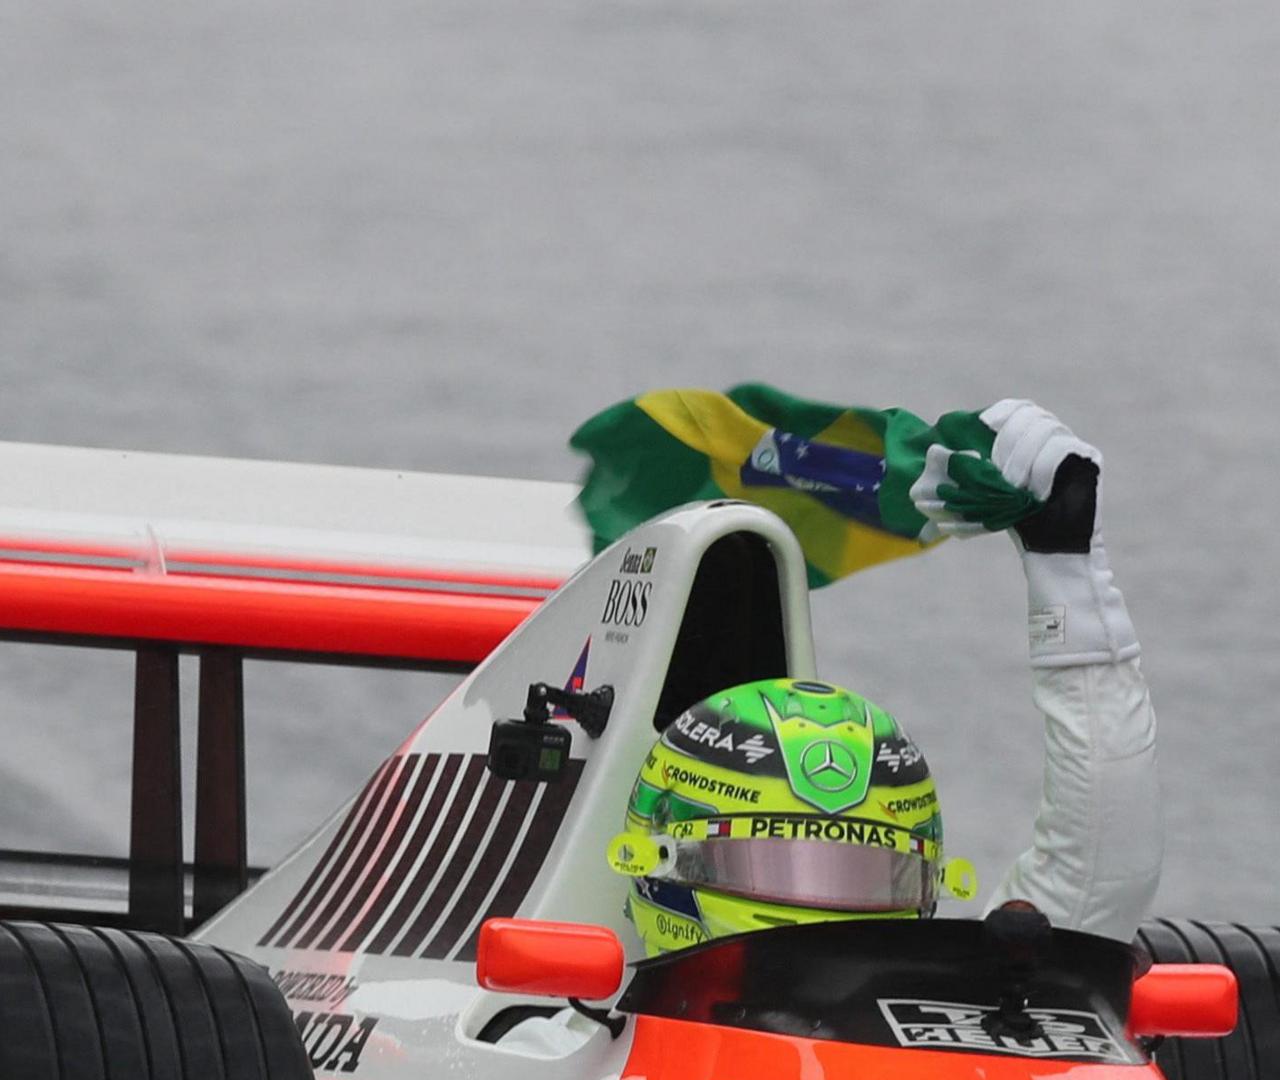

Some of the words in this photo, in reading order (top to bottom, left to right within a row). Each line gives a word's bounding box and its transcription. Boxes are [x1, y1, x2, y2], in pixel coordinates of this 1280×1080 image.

[601, 579, 653, 628] BOSS
[666, 765, 761, 803] CROWDSTRIKE
[751, 818, 897, 848] PETRONAS
[293, 1011, 380, 1073] NDA
